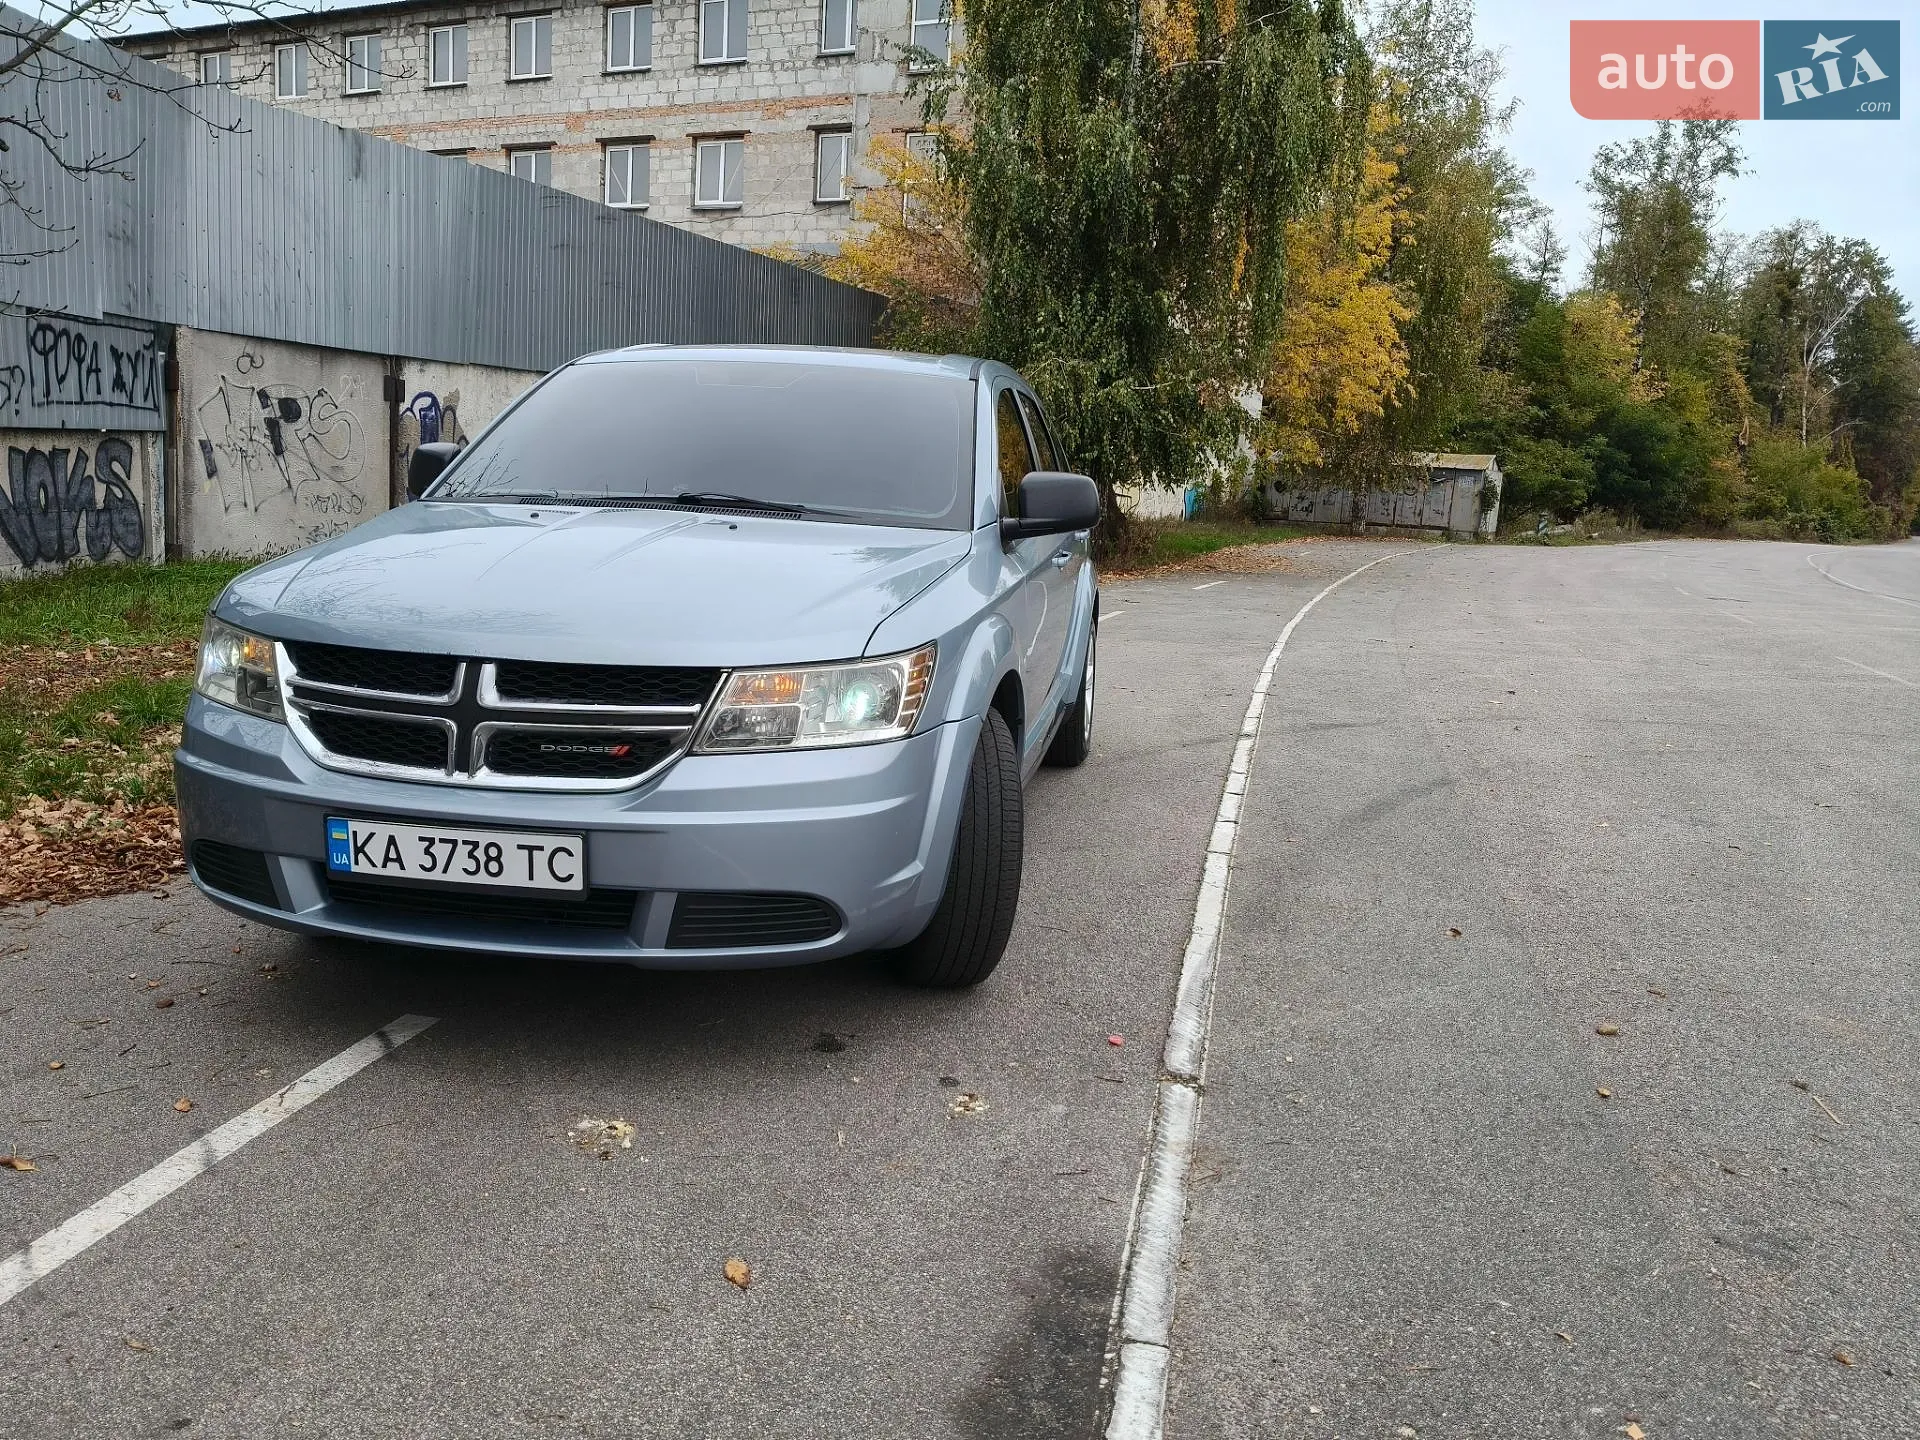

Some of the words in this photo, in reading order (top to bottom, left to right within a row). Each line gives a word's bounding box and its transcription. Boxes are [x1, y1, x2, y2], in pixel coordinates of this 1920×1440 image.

[540, 744, 619, 754] DODGE
[333, 852, 350, 866] UA
[351, 829, 407, 871] KA
[417, 835, 505, 879] 3738
[516, 843, 576, 884] TC
